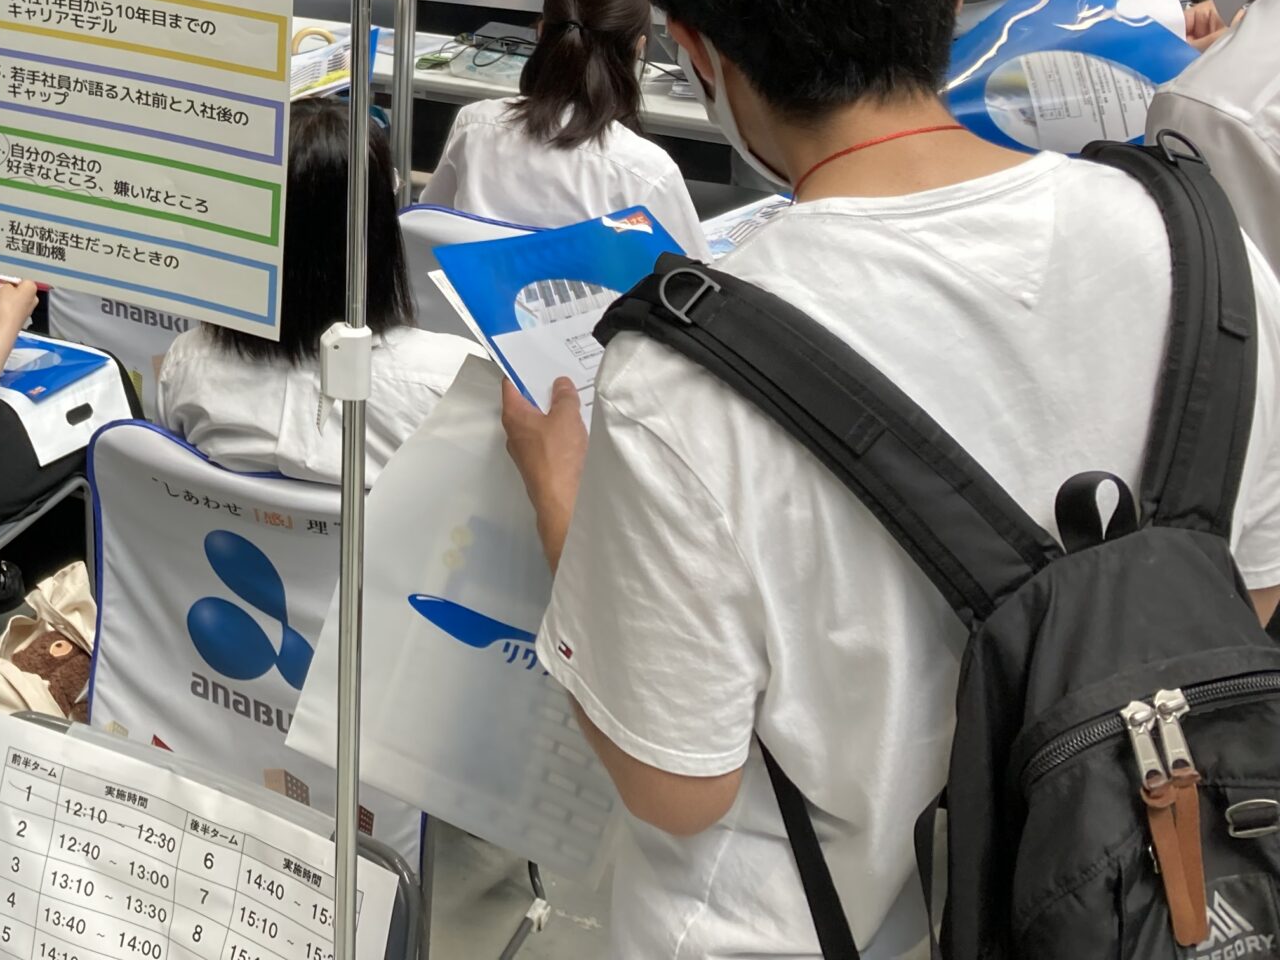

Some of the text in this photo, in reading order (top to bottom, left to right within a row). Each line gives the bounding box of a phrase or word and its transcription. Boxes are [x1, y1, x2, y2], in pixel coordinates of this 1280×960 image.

[8, 3, 117, 34] キャリアモデル
[8, 83, 69, 106] ギャップ
[10, 66, 249, 127] 若手社員が語る入社前と入社後の
[10, 143, 102, 174] 自分の会社の
[6, 159, 209, 214] 好きなところ、嫌いなところ
[5, 236, 67, 262] 志望動機
[8, 220, 179, 270] 私が就活生だったときの
[503, 641, 538, 670] リク
[11, 753, 58, 778] 前半ターム
[25, 785, 33, 802] 1
[105, 785, 149, 809] 実施時間
[16, 820, 27, 838] 2
[65, 800, 108, 824] 12:10
[137, 824, 176, 853] 12:30
[190, 819, 238, 846] 後半ターム
[11, 856, 20, 873] 3
[59, 834, 101, 860] 12:40
[129, 861, 170, 889] 13:00
[203, 852, 214, 870] 6
[283, 858, 322, 888] 実施時間
[7, 892, 16, 909] 4
[51, 871, 95, 897] 13:10
[126, 896, 167, 923] 13:30
[200, 888, 209, 905] 7
[246, 869, 285, 900] 14:40
[312, 904, 335, 929] 15:
[1, 926, 11, 943] 5
[44, 908, 86, 935] 13:40
[119, 933, 162, 960] 14:00
[192, 925, 203, 942] 8
[240, 906, 278, 939] 15:10
[40, 942, 78, 960] 14:1
[1188, 933, 1275, 960] EGORY
